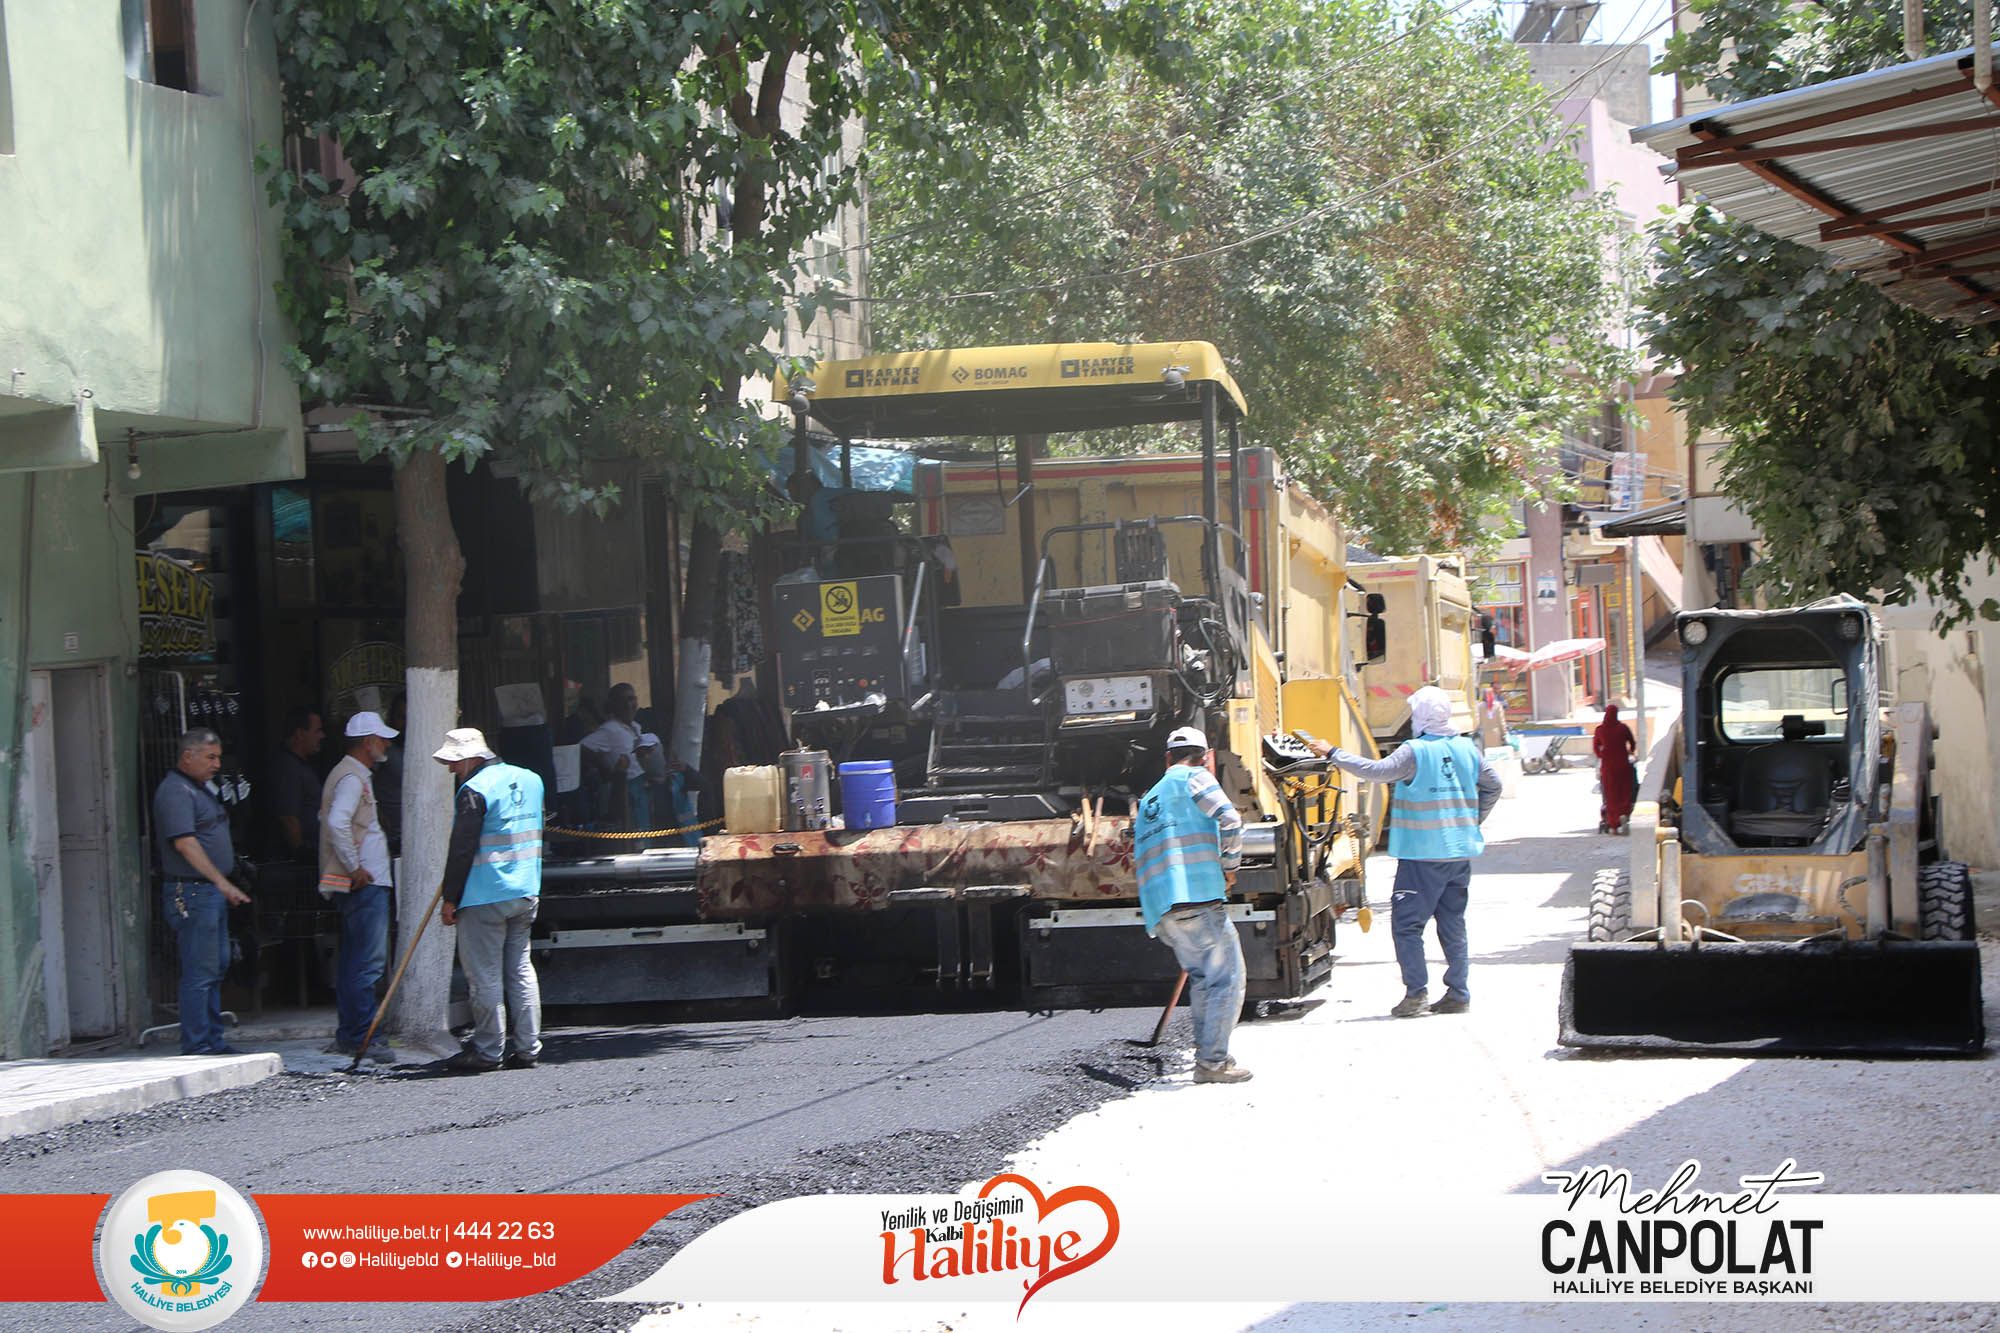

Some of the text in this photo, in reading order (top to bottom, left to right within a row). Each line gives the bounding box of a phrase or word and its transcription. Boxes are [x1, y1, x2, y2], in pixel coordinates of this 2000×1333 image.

[1082, 357, 1135, 368] KARYER
[865, 366, 920, 378] KARYER
[974, 366, 1029, 379] BOMAG
[1083, 366, 1134, 377] TATMAK
[865, 375, 919, 387] TATMAK
